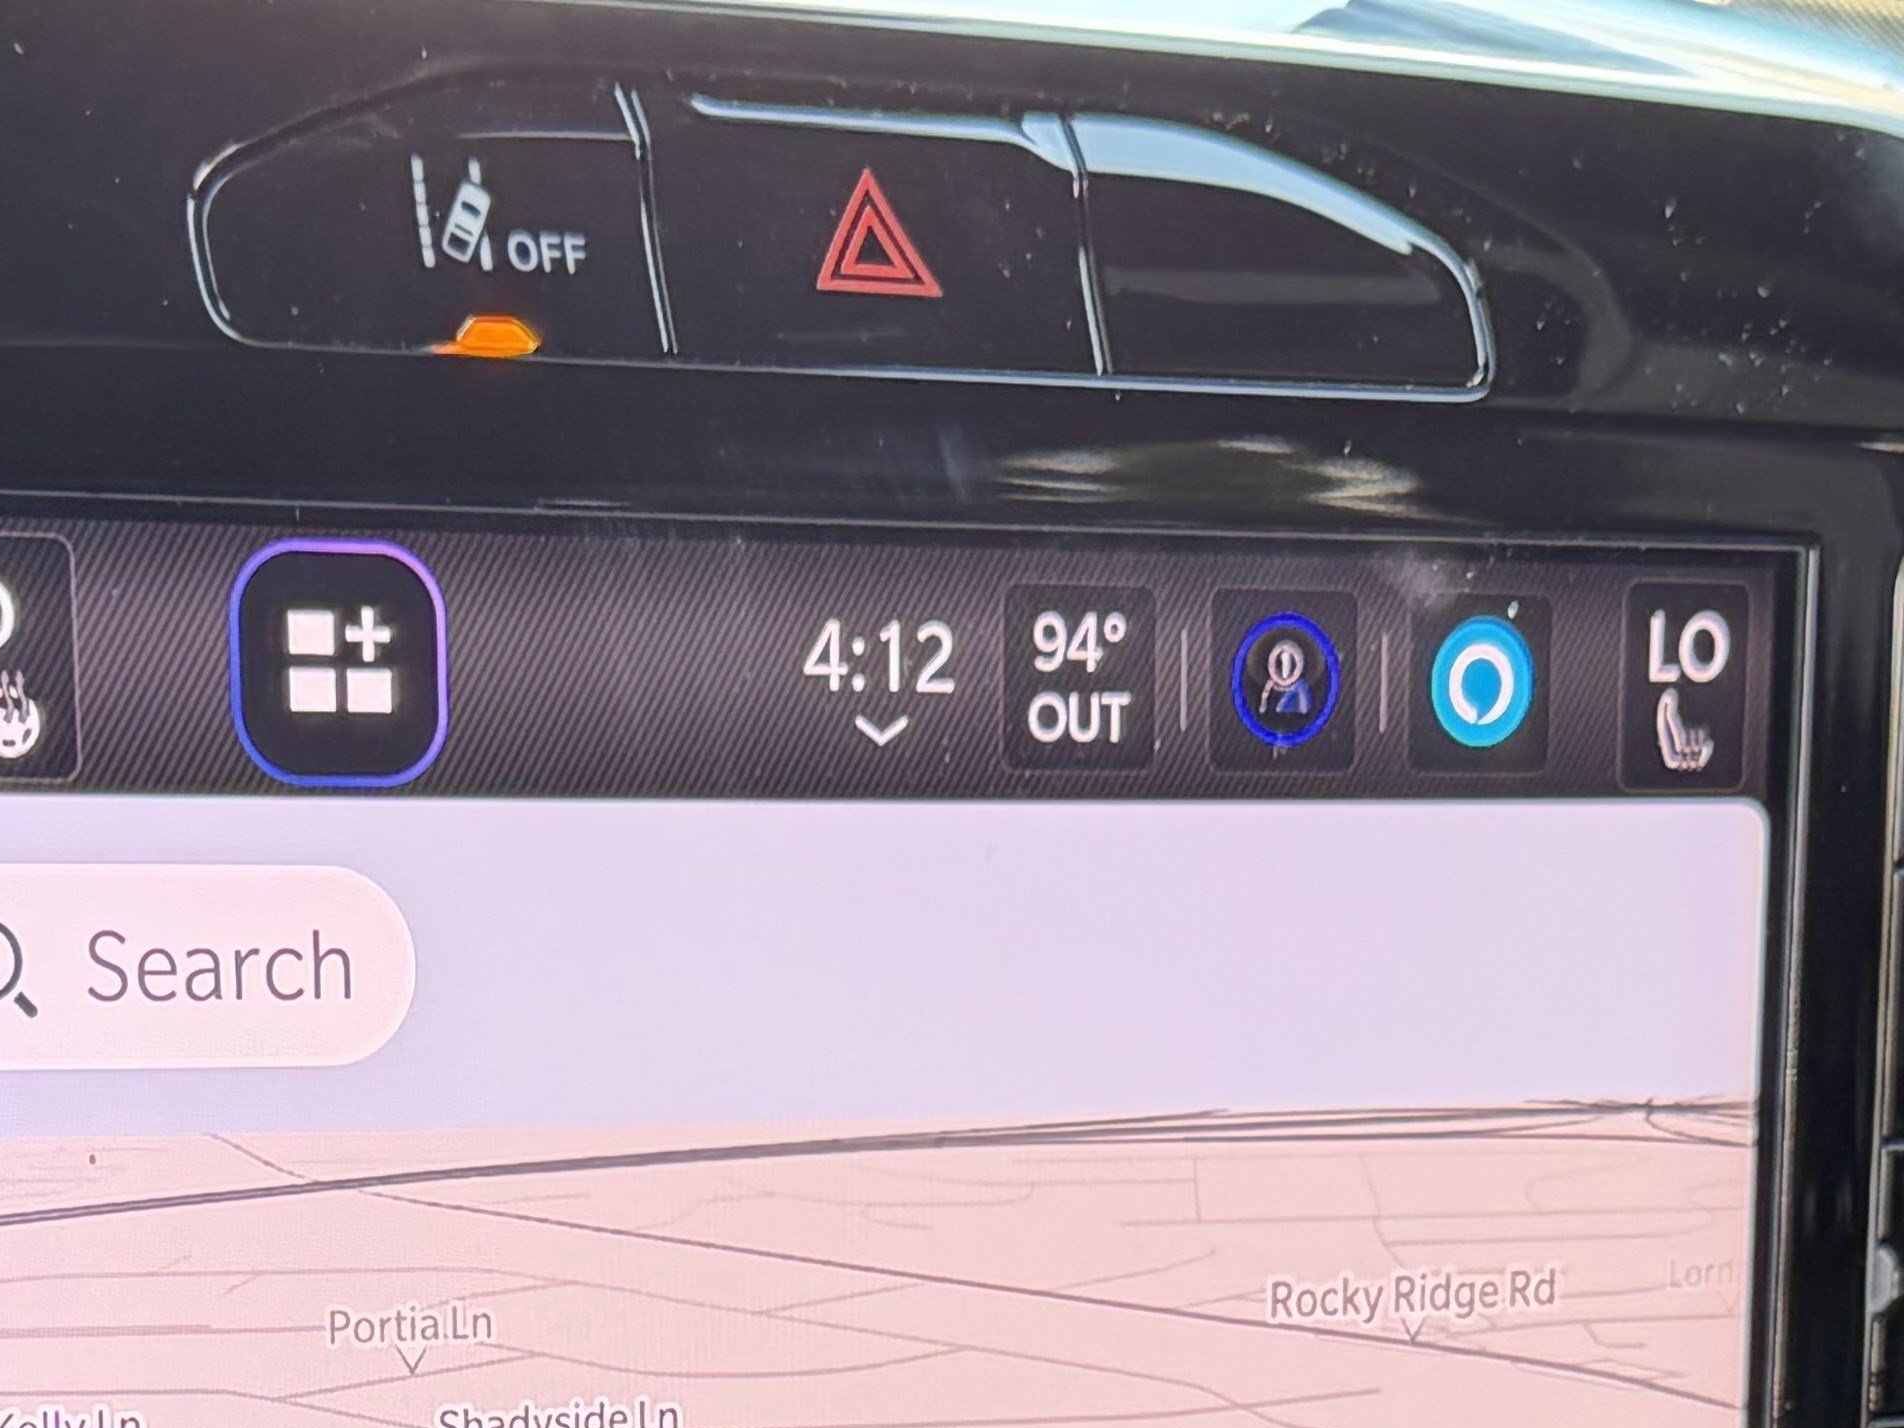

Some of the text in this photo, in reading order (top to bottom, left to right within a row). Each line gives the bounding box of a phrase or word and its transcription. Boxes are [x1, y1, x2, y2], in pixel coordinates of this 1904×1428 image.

[507, 230, 586, 275] OFF
[802, 618, 955, 694] 4:12
[1649, 608, 1730, 685] LO
[1027, 692, 1130, 743] OUT
[86, 929, 353, 1004] Search
[1270, 1269, 1557, 1320] Rocky Ridge Rd
[328, 1308, 493, 1345] Portia Ln
